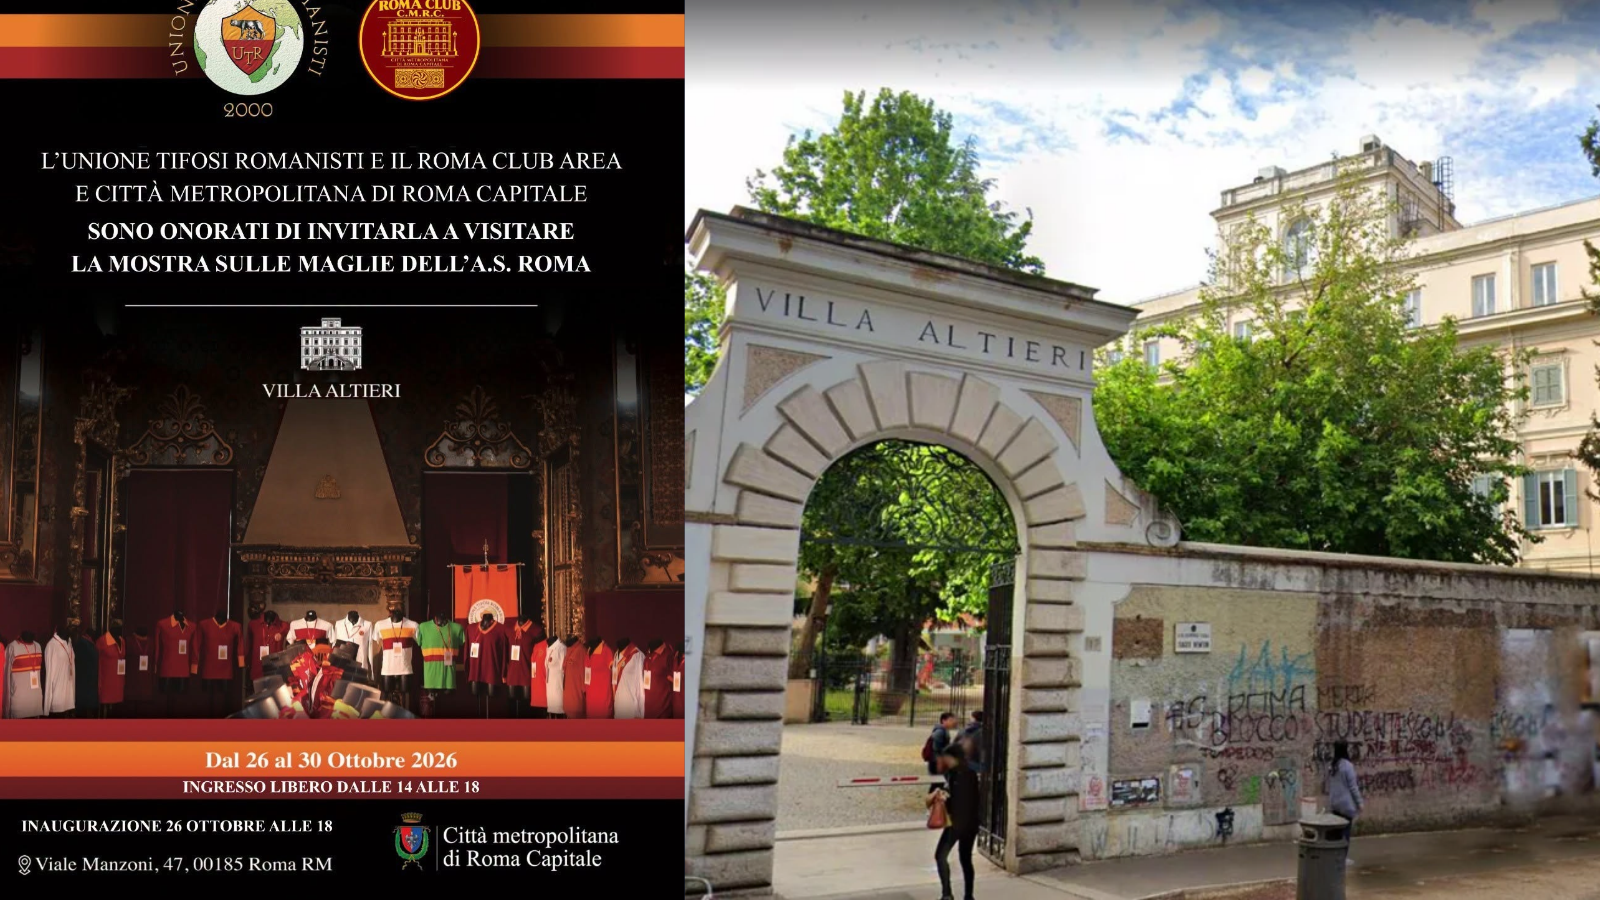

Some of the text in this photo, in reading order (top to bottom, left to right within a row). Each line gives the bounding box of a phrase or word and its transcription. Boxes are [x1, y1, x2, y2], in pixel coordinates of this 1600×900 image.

[379, 0, 461, 11] ROMA CLUB
[396, 9, 445, 17] C.M.R.C.
[302, 0, 329, 77] ANISTI
[232, 46, 264, 66] UTR
[223, 102, 273, 118] 2000
[42, 151, 622, 170] L’UNIONE TIFOSI ROMANISTI E IL ROMA CLUB AREA
[76, 180, 587, 203] E CITTÀ METROPOLITANA DI ROMA CAPITALE
[88, 222, 575, 240] SONO ONORATI DI INVITARLA A VISITARE
[71, 255, 103, 273] LA
[108, 254, 210, 273] MOSTRA
[215, 254, 291, 273] SULLE
[298, 254, 395, 273] MAGLIE
[518, 255, 591, 273] ROMA
[756, 287, 1087, 372] VILLA ALTIERI
[262, 383, 401, 398] VILLA ALTIERI
[204, 752, 457, 768] Dal 26 al 30 Ottobre 2026
[182, 780, 480, 793] INGRESSO LIBERO DALLE 14 ALLE 18
[21, 819, 333, 832] INAUGURAZIONE 26 OTTOBRE ALLE 18
[443, 826, 620, 849] Città metropolitana
[35, 856, 332, 875] Viale Manzoni, 47, 00185 Roma RM
[443, 849, 602, 872] di Roma Capitale
